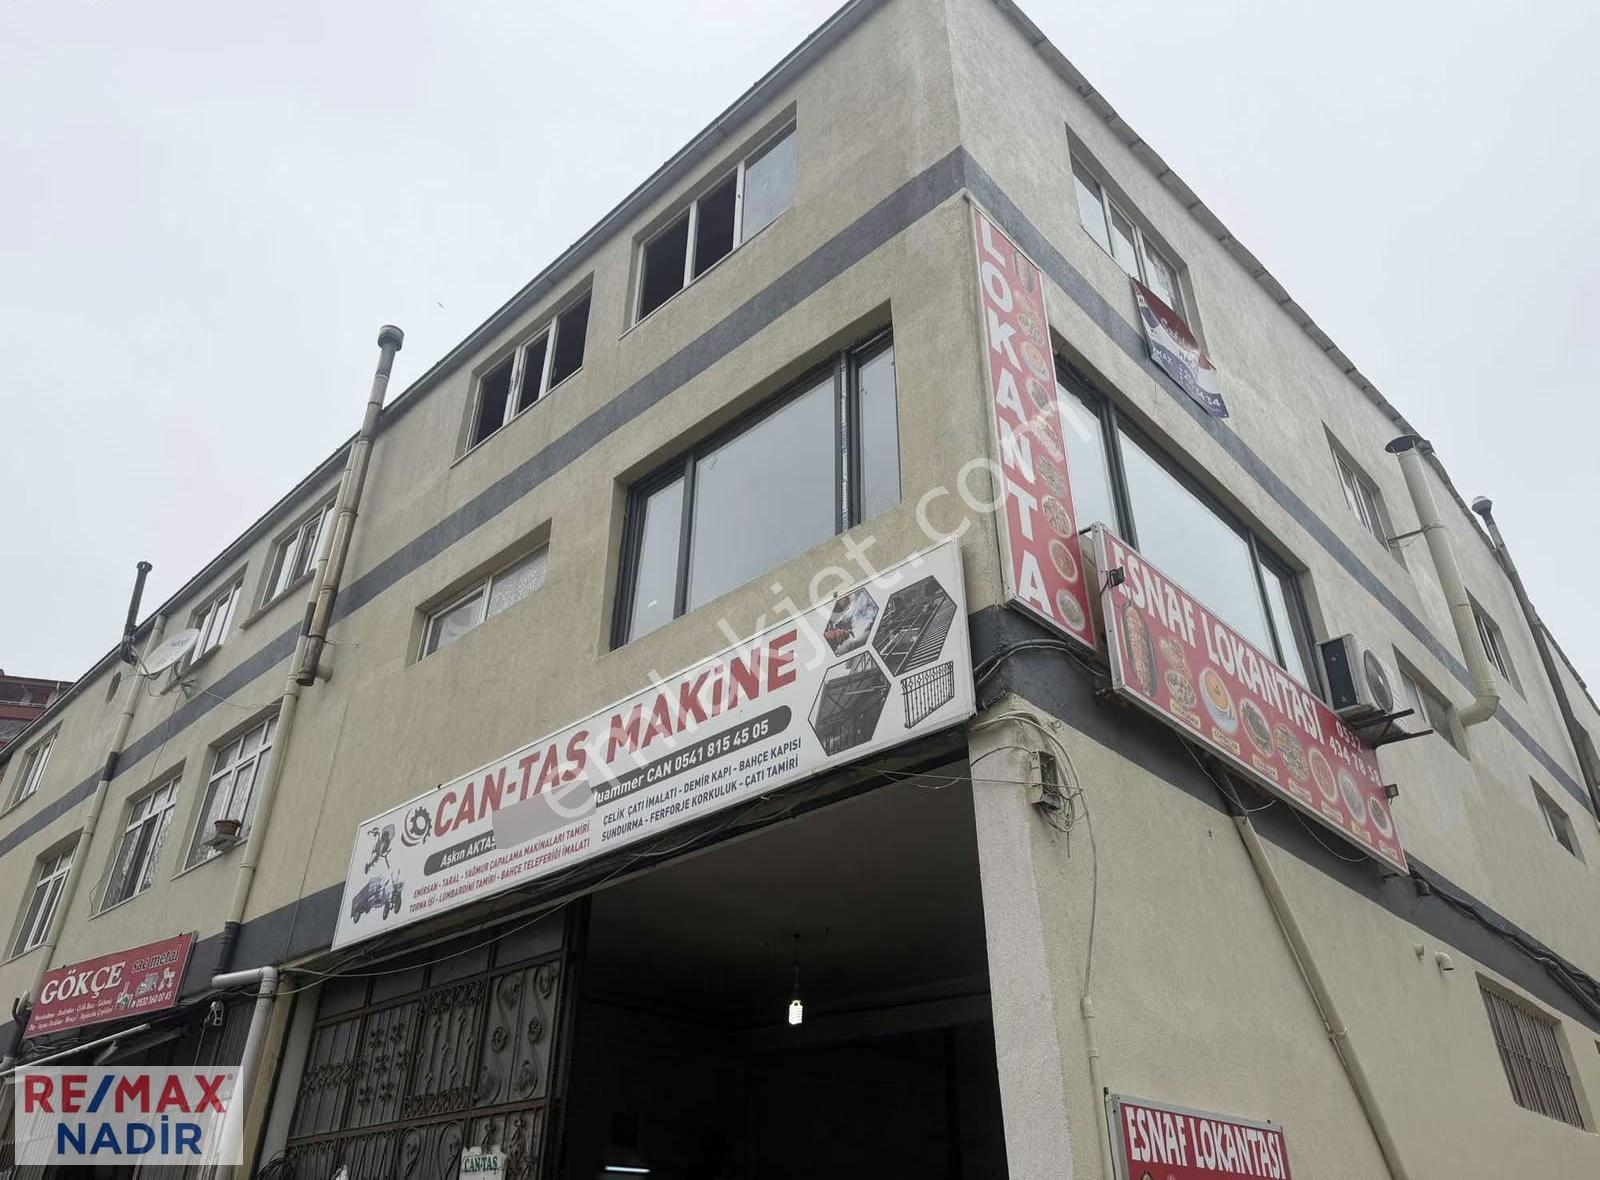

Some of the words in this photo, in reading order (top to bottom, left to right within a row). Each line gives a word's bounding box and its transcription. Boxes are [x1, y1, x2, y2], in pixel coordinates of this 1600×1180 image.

[980, 215, 1053, 618] LOKANTA
[1110, 540, 1196, 648] ESNAF
[1200, 609, 1325, 746] LOKANTASI
[606, 629, 798, 764] MAKİNE
[602, 807, 625, 826] ÇELİK
[628, 800, 645, 817] ÇATI
[645, 787, 677, 809] İMALATI
[683, 774, 710, 794] DEMİR
[711, 765, 732, 782] KAPI
[739, 750, 769, 772] BAHÇE
[770, 738, 801, 759] KAPISI
[646, 759, 672, 783] CAN
[675, 746, 703, 771] 0541
[707, 735, 731, 758] 815
[733, 727, 750, 746] 45
[752, 719, 769, 739] 05
[1329, 735, 1351, 766] 434
[566, 822, 590, 840] TAMİRİ
[601, 817, 643, 842] SUNDURMA
[649, 798, 690, 823] FERFORJE
[691, 780, 738, 808] KORKULUK
[744, 770, 765, 789] ÇATI
[767, 754, 799, 779] TAMİRİ
[562, 838, 590, 857] İMALATI
[41, 961, 126, 1005] GÖKÇE
[1125, 1105, 1188, 1167] ESNAF
[1189, 1117, 1287, 1179] LOKANTASI
